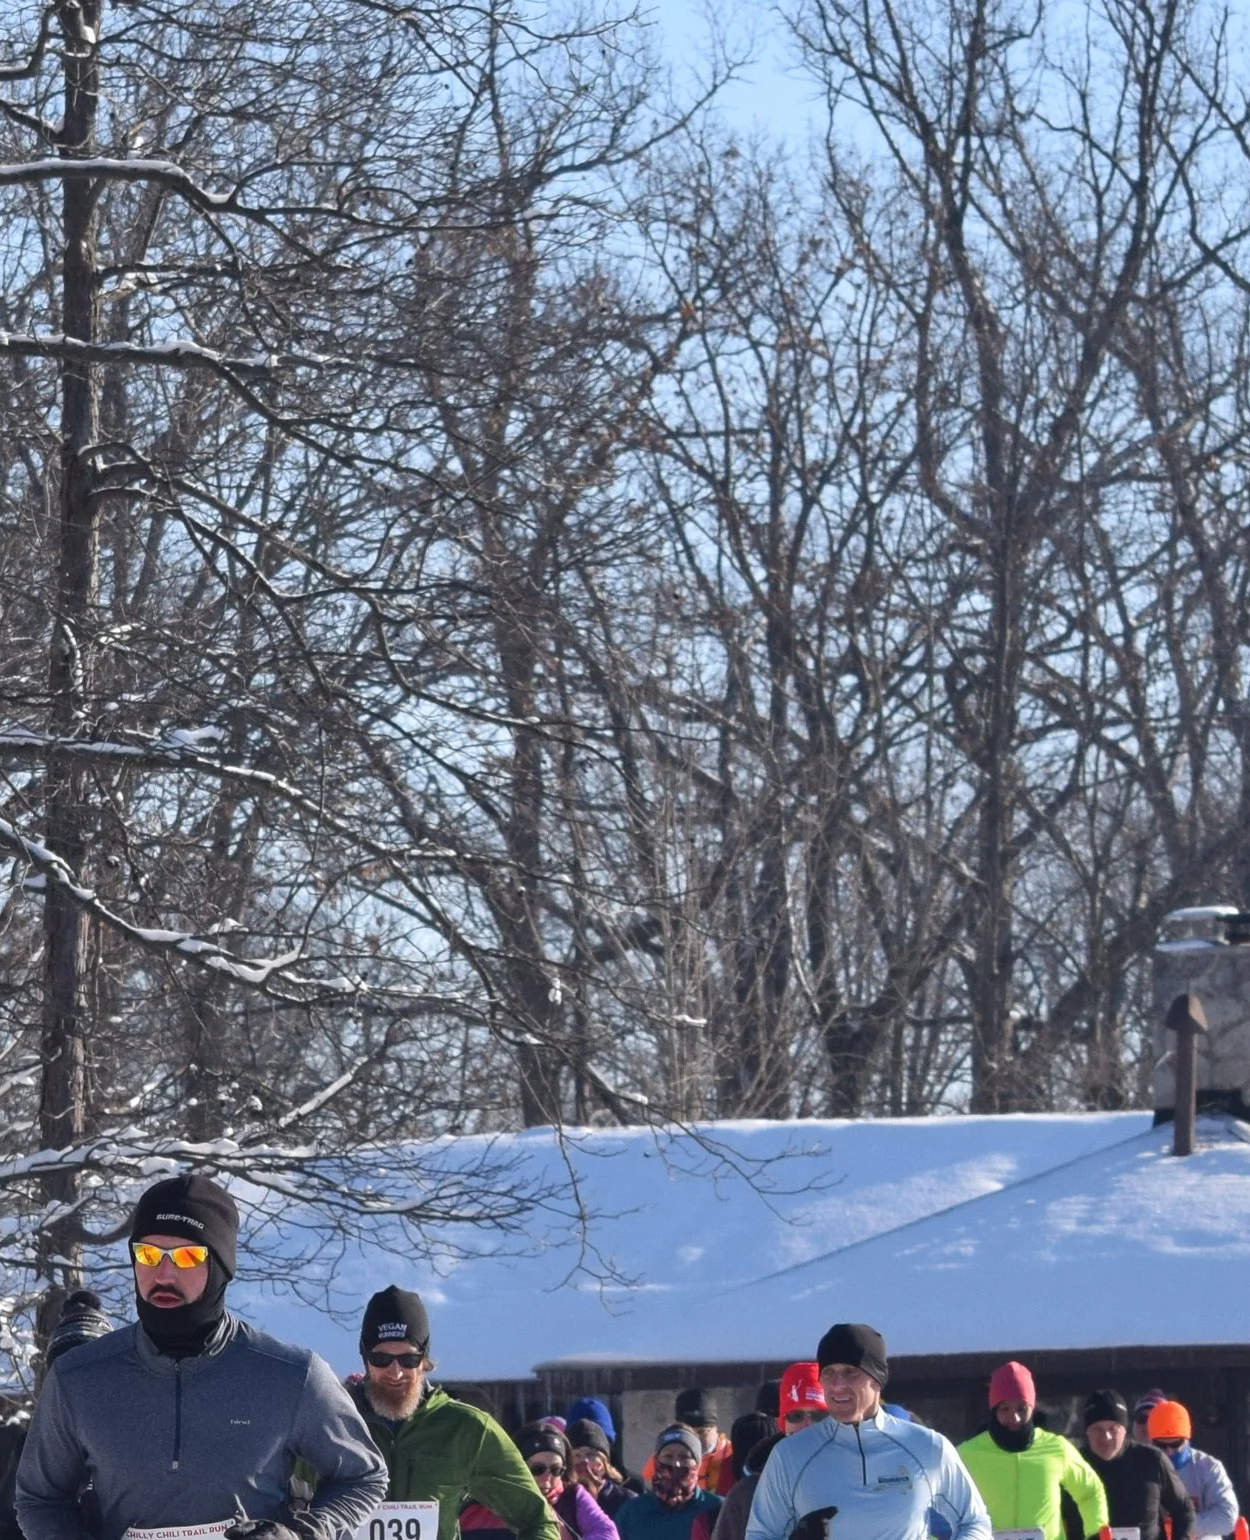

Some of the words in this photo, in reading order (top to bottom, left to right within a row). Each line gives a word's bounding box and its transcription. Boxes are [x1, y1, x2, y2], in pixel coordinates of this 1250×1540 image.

[378, 1322, 407, 1332] VEGAN
[126, 1530, 154, 1539] CHILLY
[156, 1530, 179, 1538] CHILI
[182, 1528, 207, 1537] TRAIL
[209, 1524, 228, 1533] RUN
